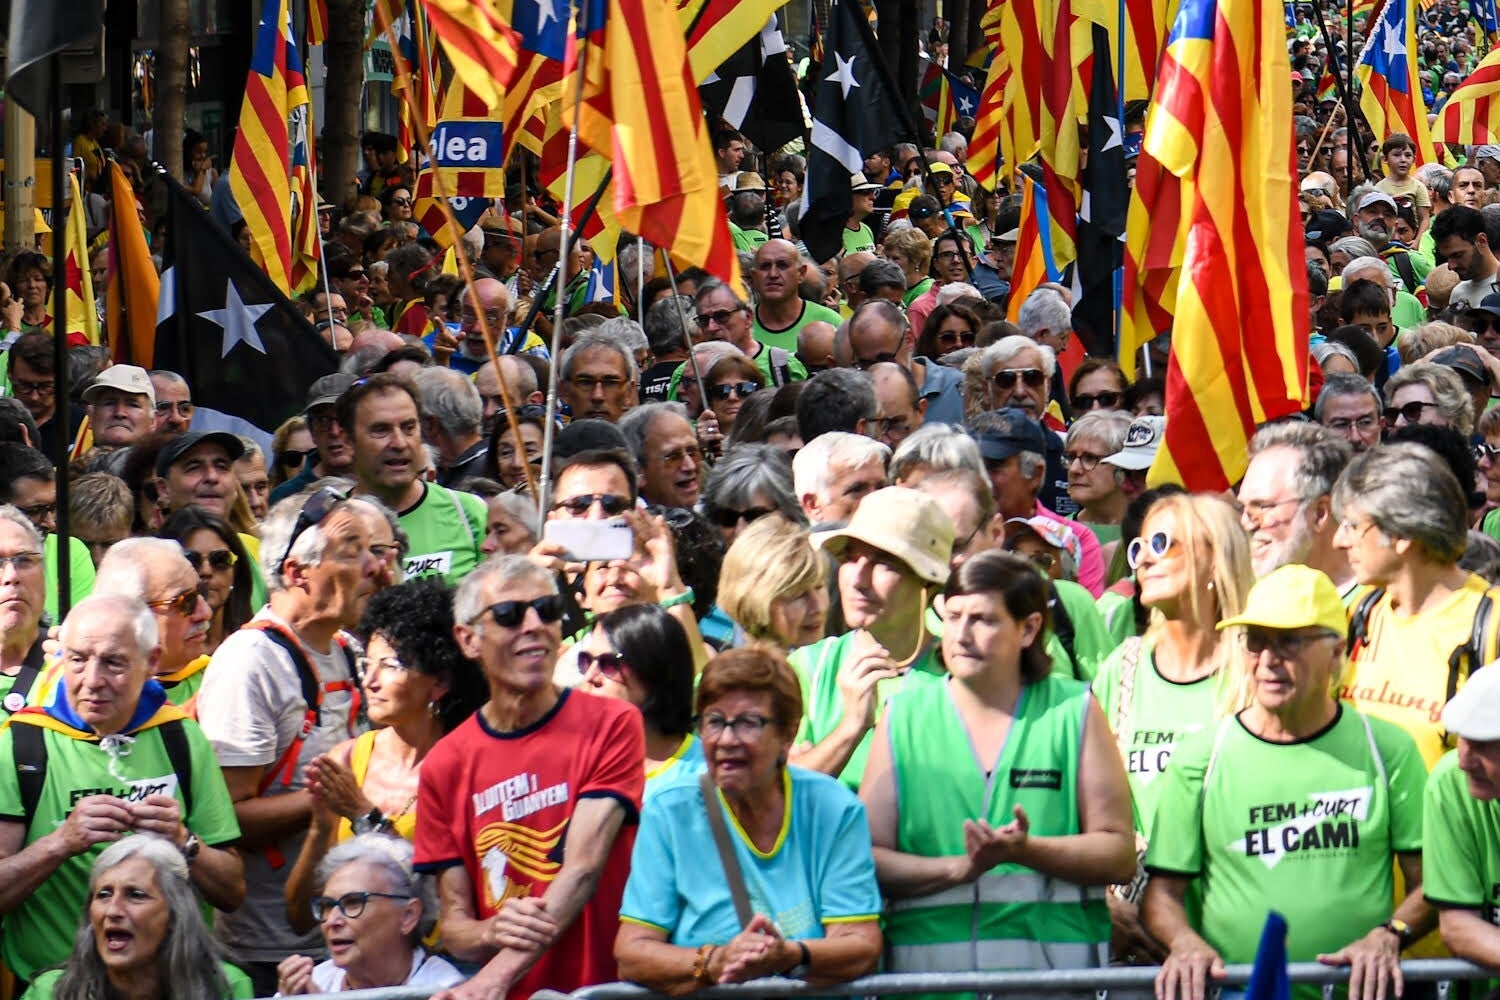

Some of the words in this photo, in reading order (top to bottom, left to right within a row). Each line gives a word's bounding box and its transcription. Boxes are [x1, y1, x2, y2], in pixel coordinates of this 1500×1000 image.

[1133, 731, 1175, 745] FEM
[1128, 750, 1150, 774] EL
[1248, 802, 1297, 825] FEM
[1244, 827, 1276, 857] EL
